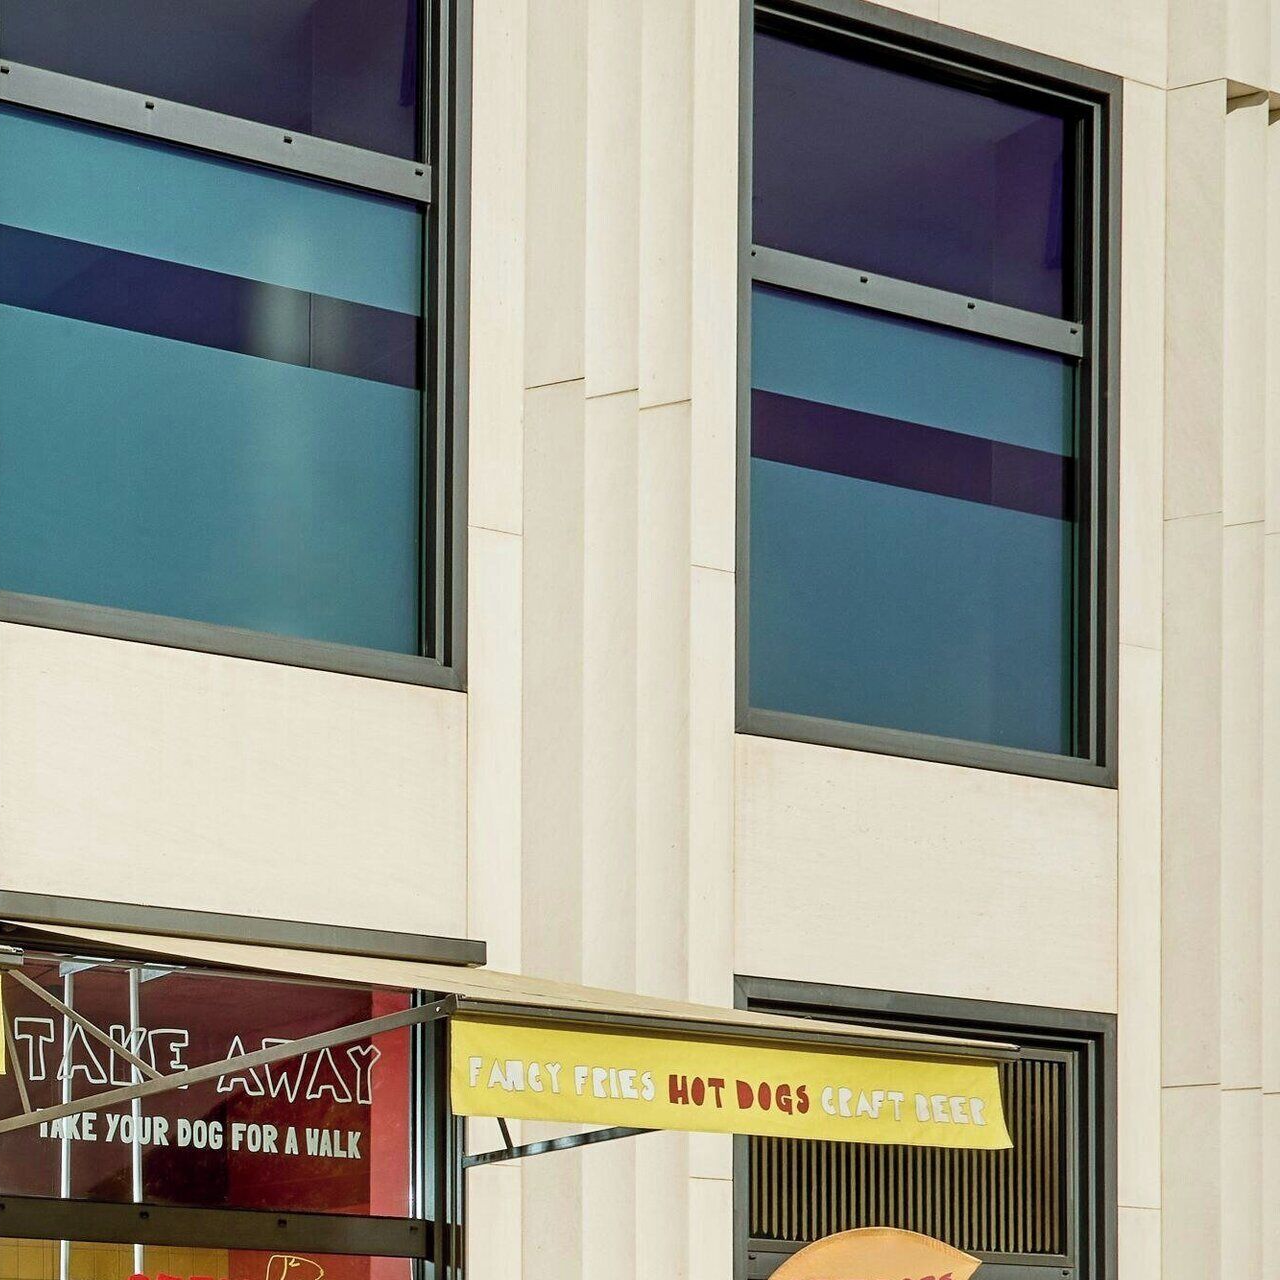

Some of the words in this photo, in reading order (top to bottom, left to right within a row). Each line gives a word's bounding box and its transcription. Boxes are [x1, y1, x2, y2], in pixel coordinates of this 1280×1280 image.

[14, 1017, 188, 1089] TAKE
[216, 1035, 382, 1105] AWAY
[469, 1056, 561, 1094] FANCY
[574, 1066, 656, 1102] FRIES
[668, 1074, 725, 1110] HOT
[736, 1079, 809, 1116] DOGS
[821, 1086, 906, 1121] CRAFT
[915, 1093, 986, 1126] BEER
[38, 1109, 97, 1142] TAKE
[106, 1113, 169, 1146] YOUR
[177, 1118, 223, 1150] DOG
[231, 1123, 276, 1154] FOR
[284, 1127, 299, 1155] A
[306, 1129, 361, 1159] WALK
